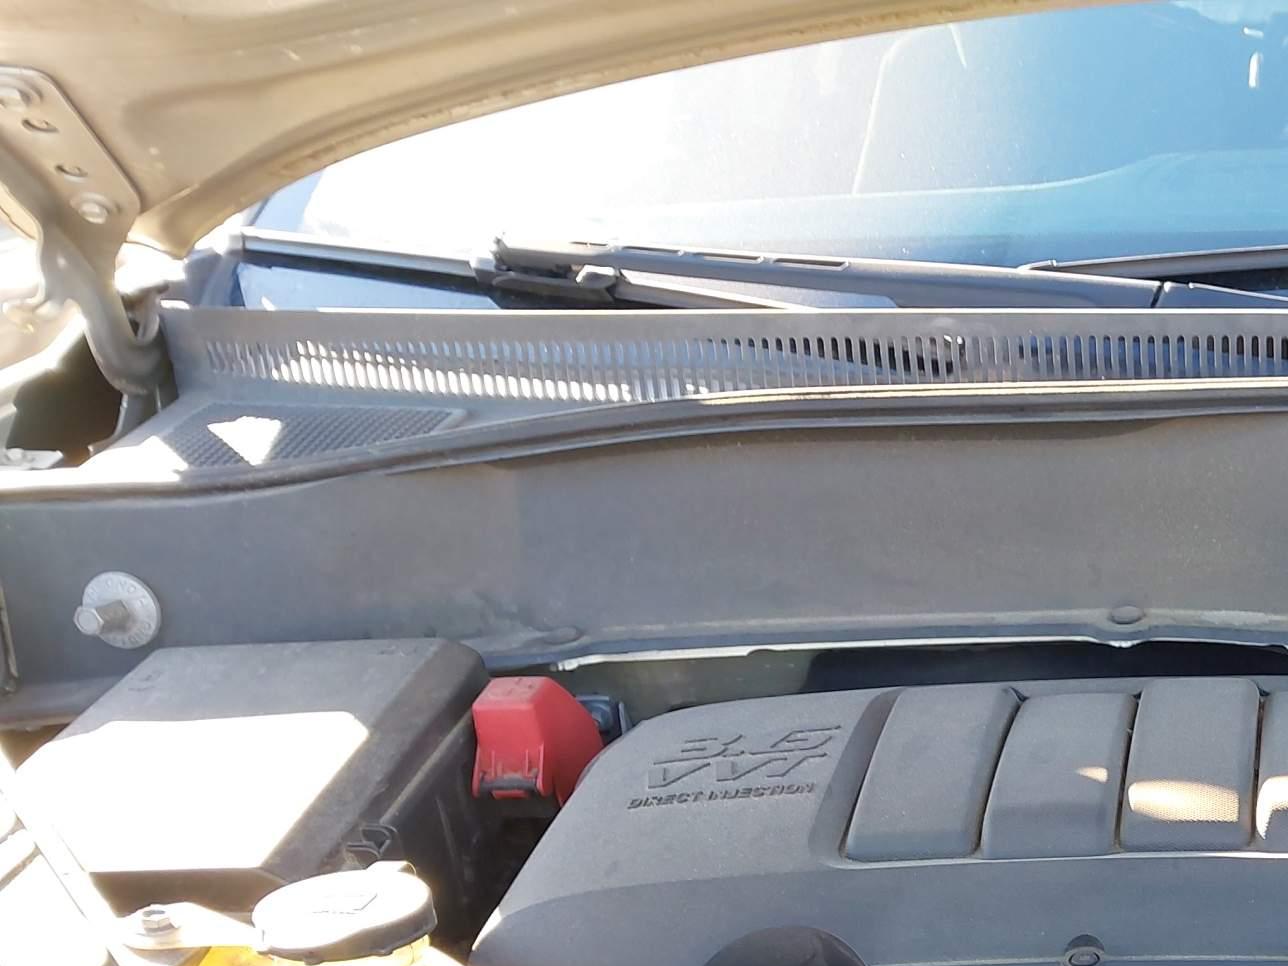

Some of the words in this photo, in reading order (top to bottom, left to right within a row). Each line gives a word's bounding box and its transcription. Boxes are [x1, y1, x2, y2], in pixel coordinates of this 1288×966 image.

[653, 724, 842, 765] 3.6
[647, 752, 828, 790] VVT
[627, 791, 699, 810] DIRECT
[706, 783, 816, 803] INJECTION
